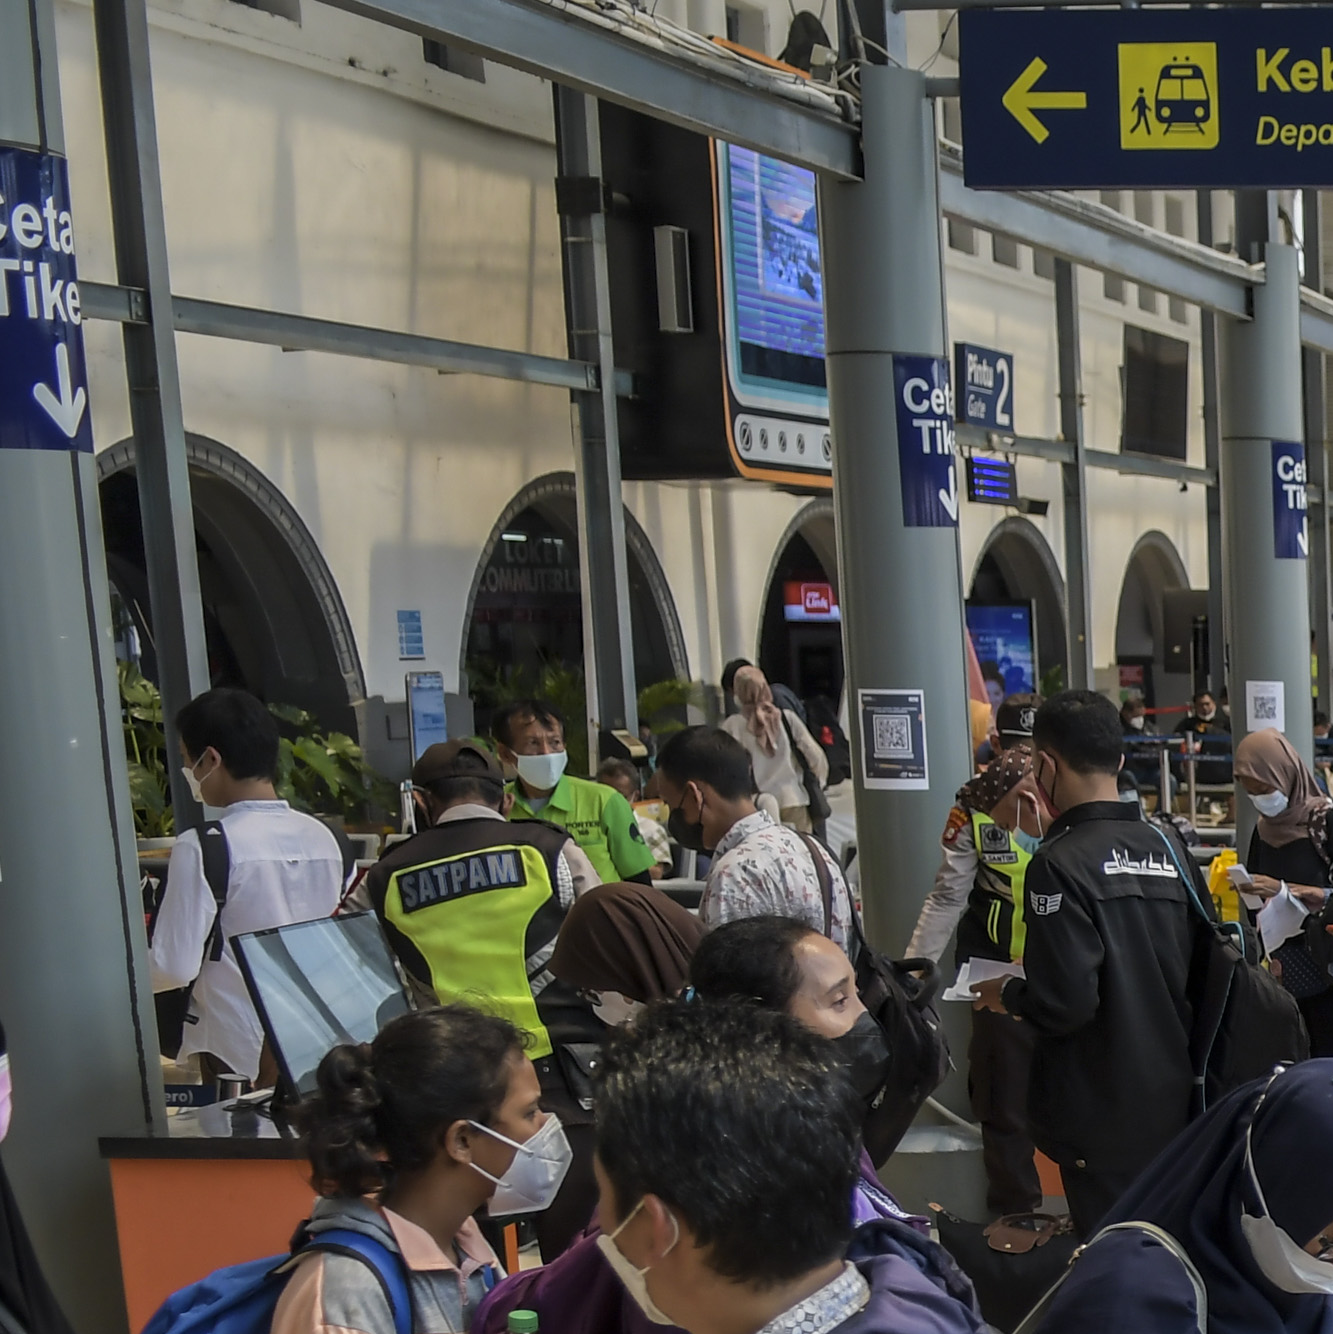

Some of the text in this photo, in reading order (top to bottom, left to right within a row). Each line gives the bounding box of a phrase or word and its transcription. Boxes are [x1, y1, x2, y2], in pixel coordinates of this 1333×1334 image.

[967, 353, 994, 389] Pintu
[903, 377, 954, 416] Cet
[967, 394, 987, 420] Gate
[995, 357, 1011, 427] 2
[912, 419, 956, 456] Tik
[401, 853, 519, 907] SATPAM
